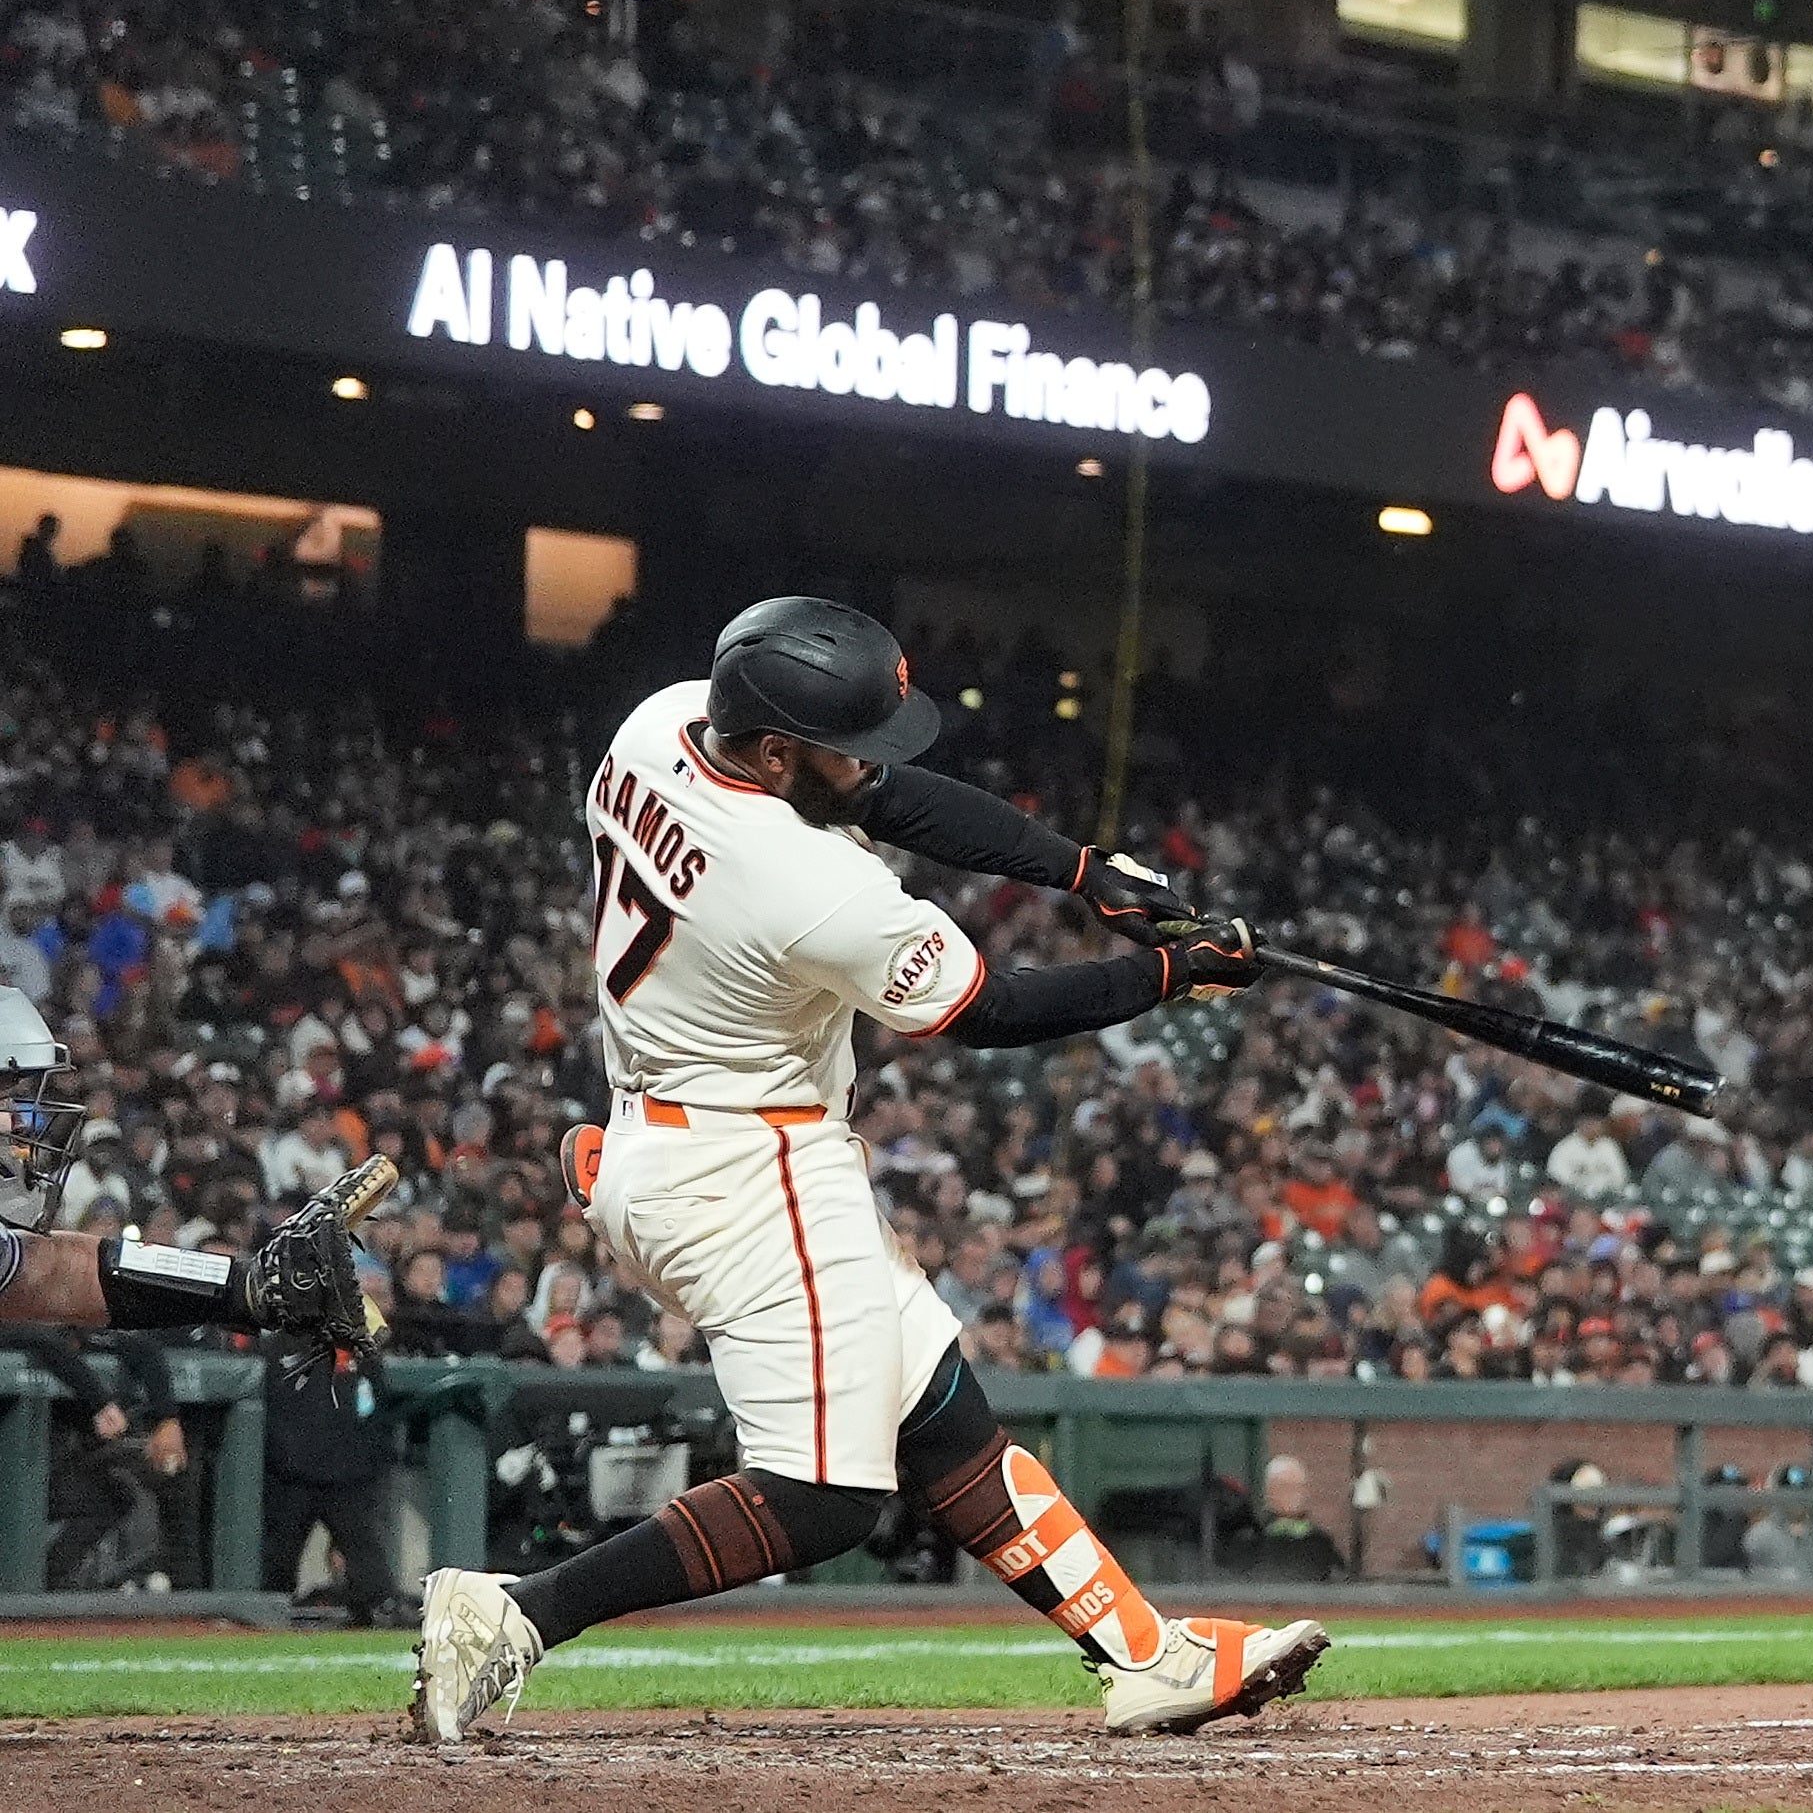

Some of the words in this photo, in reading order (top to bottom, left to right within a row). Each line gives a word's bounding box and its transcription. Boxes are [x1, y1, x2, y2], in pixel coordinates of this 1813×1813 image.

[407, 243, 493, 346] AI
[508, 253, 732, 378] Native
[740, 289, 959, 411] Global
[967, 320, 1212, 444] Finance
[596, 753, 706, 900] RAMOS
[592, 831, 676, 1006] 17
[884, 931, 945, 1005] GIANTS
[992, 1529, 1049, 1580] IOT
[1054, 1580, 1115, 1634] MOS
